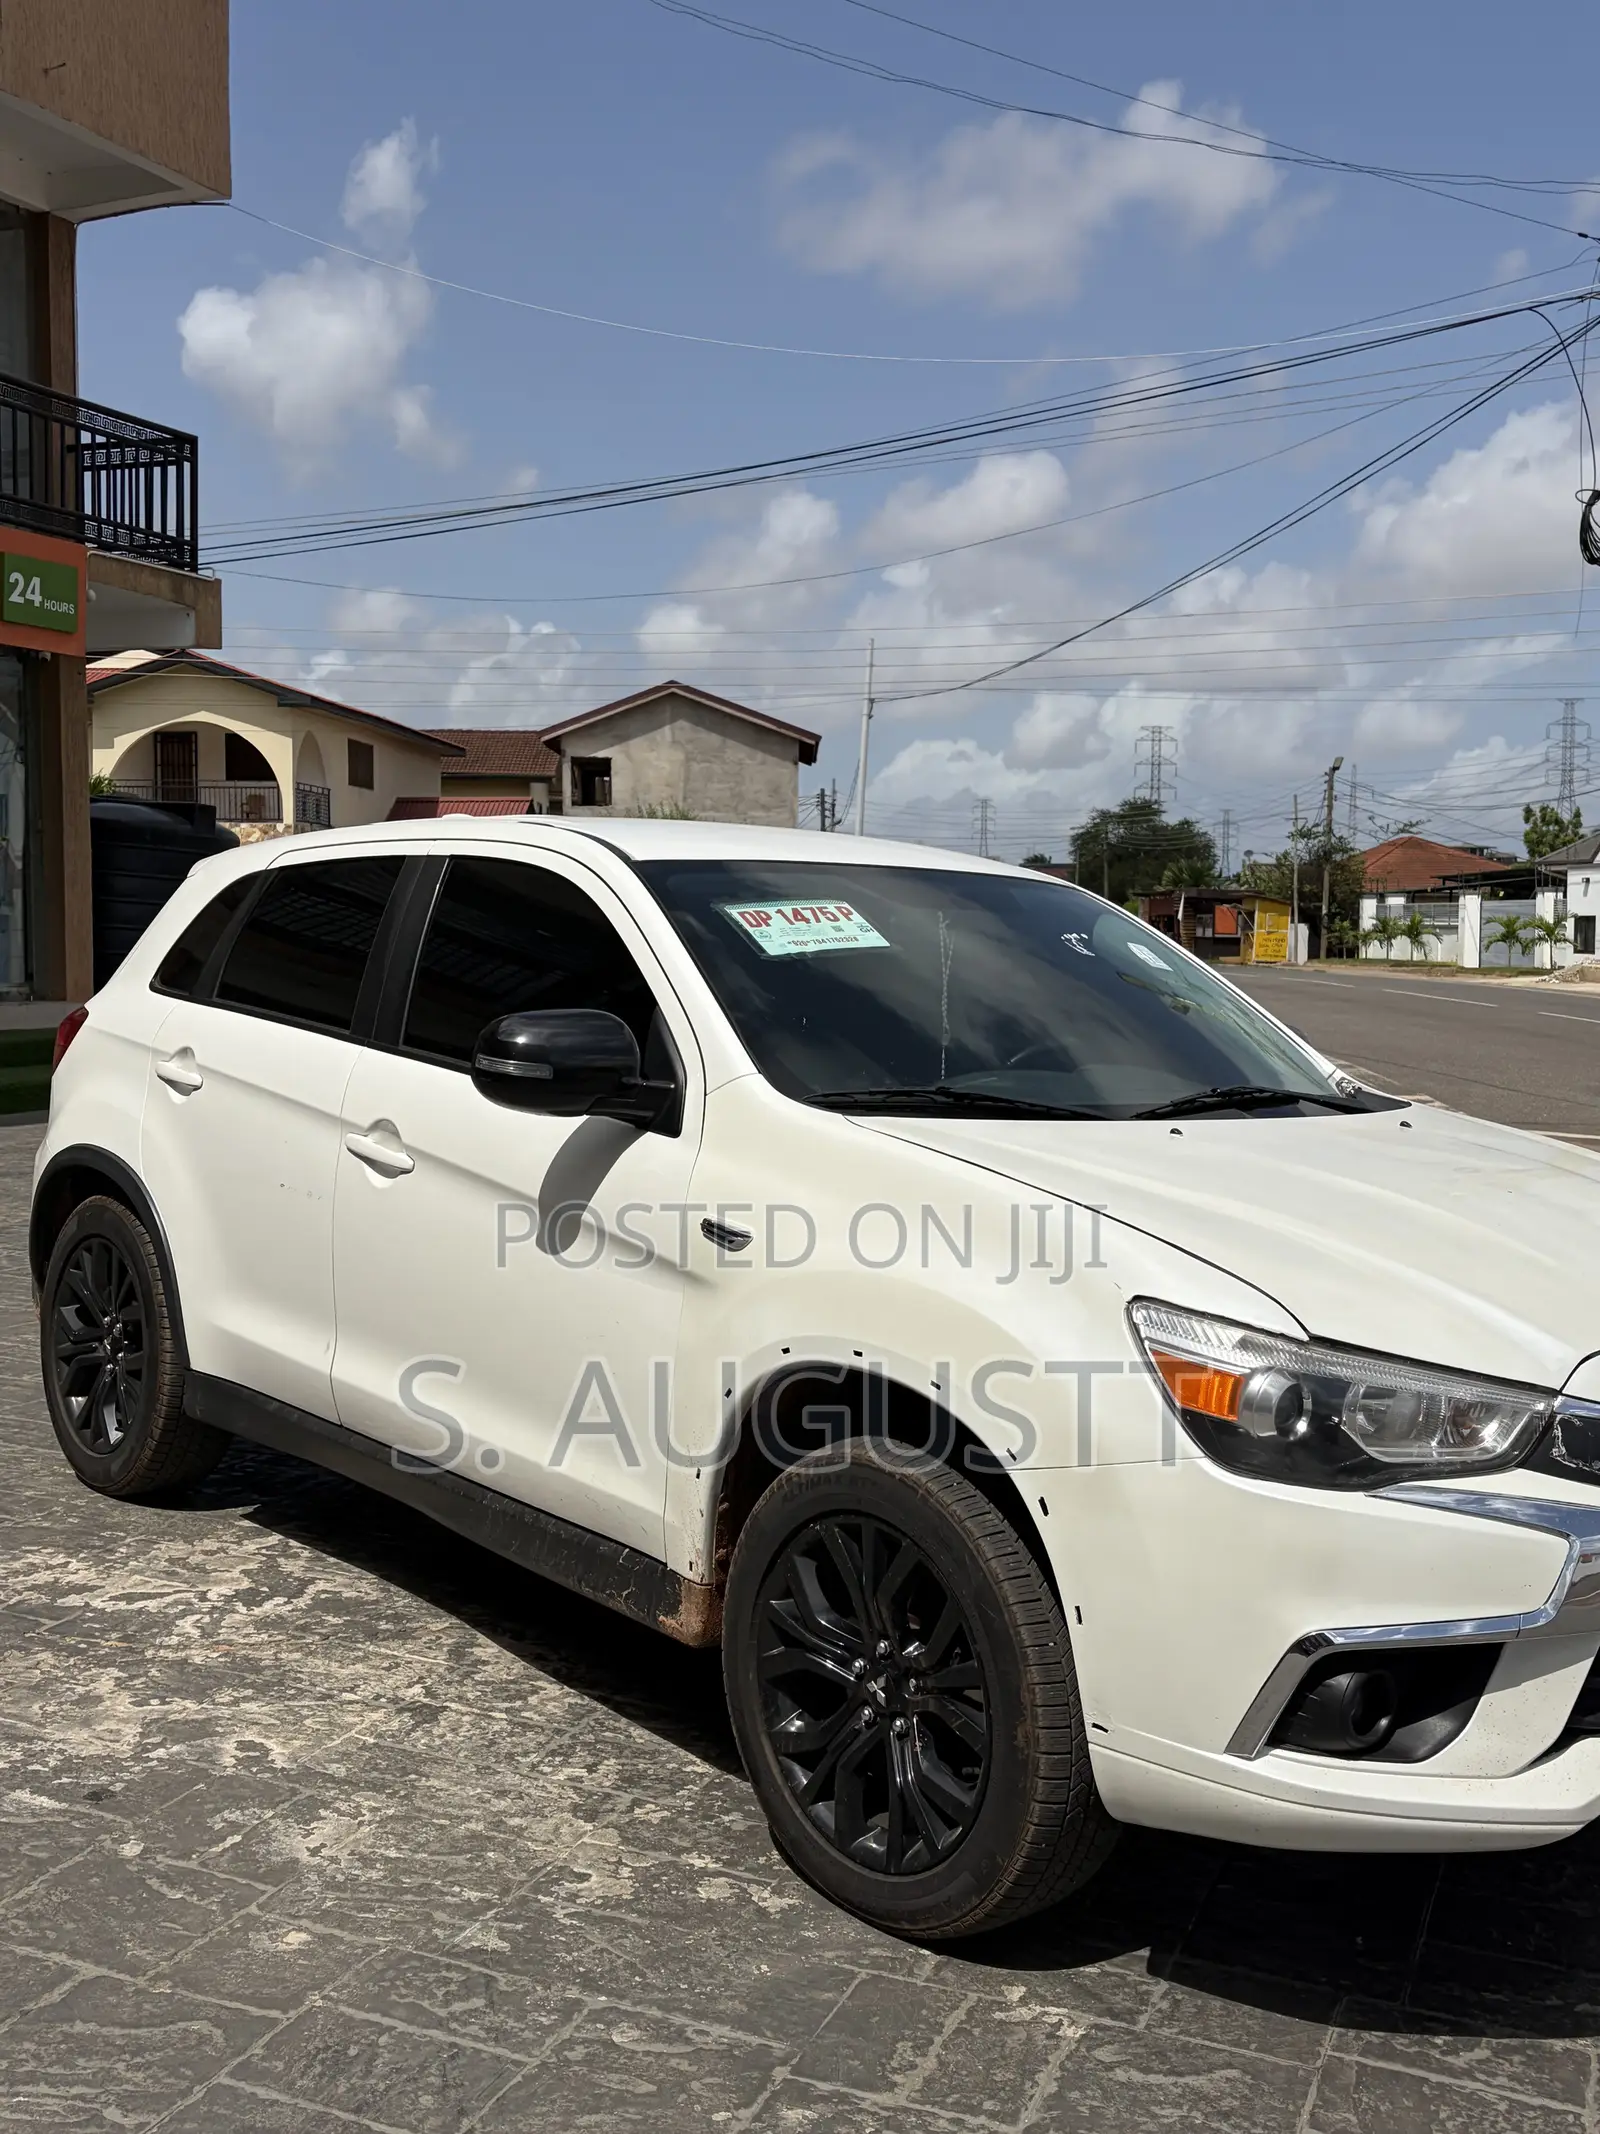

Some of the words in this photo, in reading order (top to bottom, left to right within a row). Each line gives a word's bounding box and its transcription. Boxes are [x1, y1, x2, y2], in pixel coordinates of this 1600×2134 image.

[8, 572, 42, 607] 24
[44, 598, 75, 615] HOURS
[737, 910, 773, 928] DP
[775, 905, 841, 926] 1475
[841, 905, 854, 922] P
